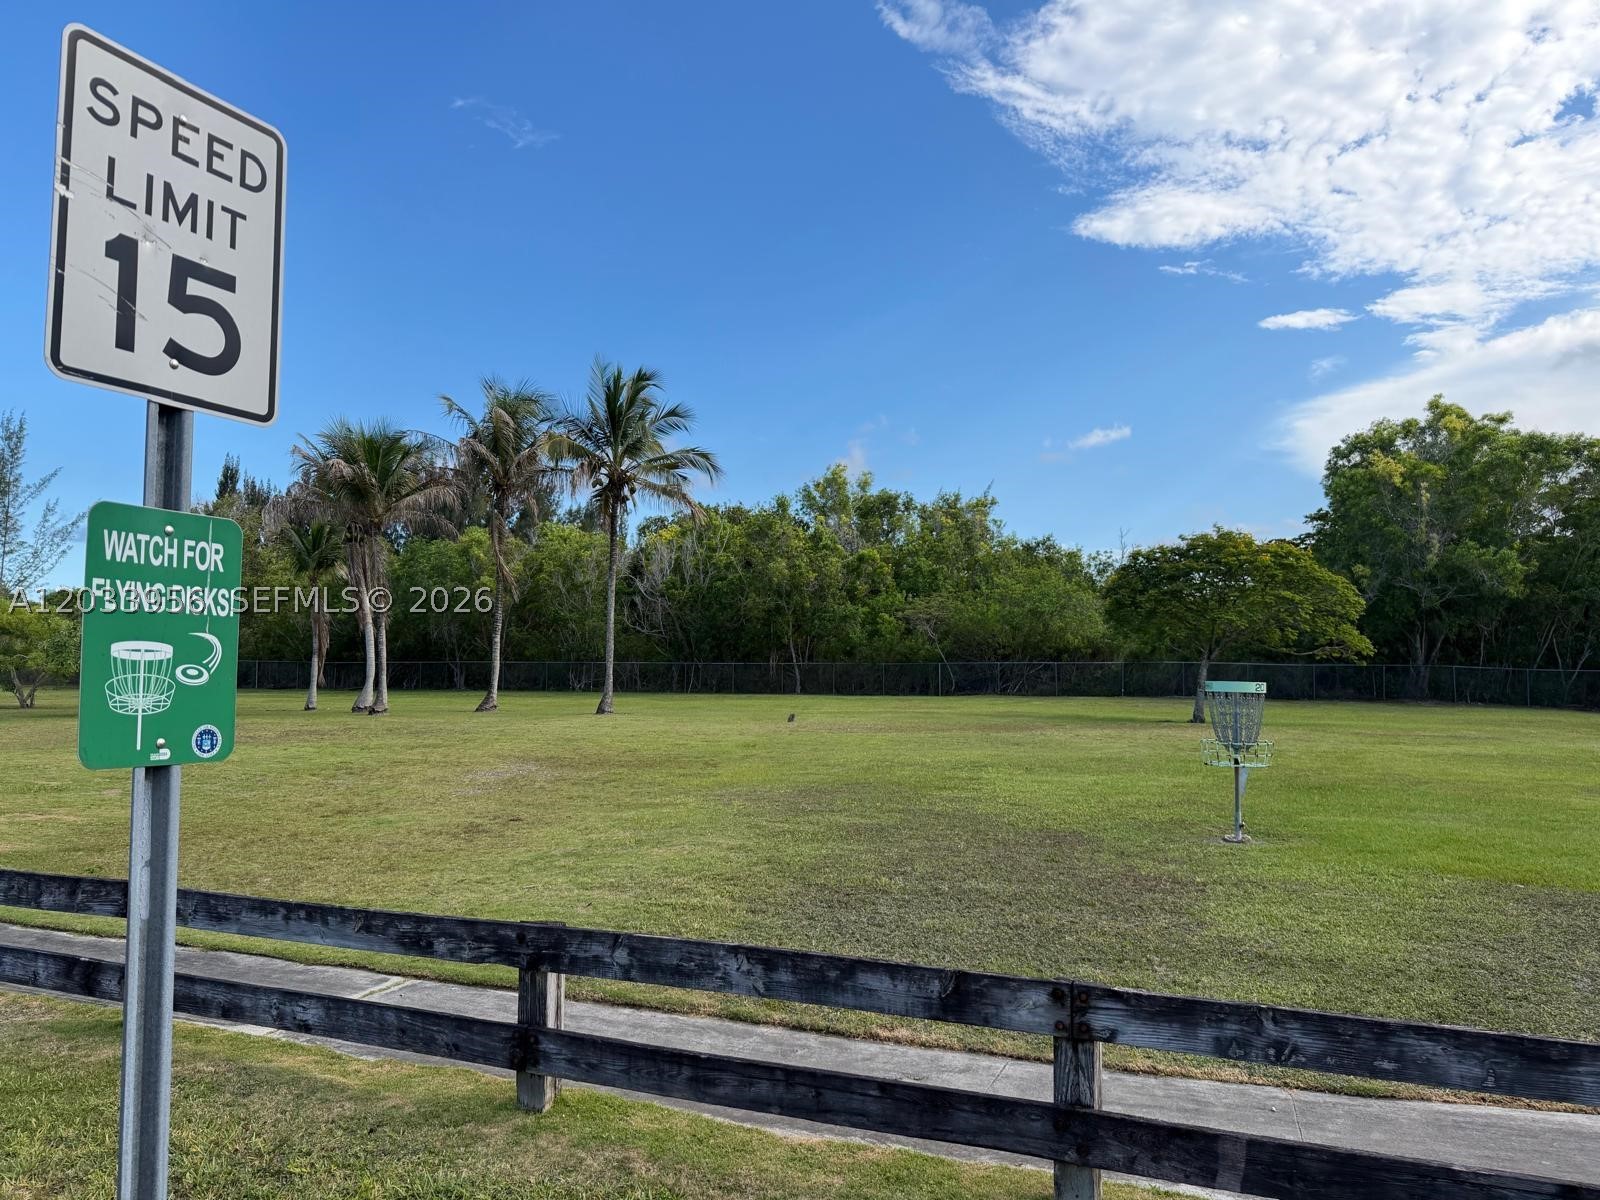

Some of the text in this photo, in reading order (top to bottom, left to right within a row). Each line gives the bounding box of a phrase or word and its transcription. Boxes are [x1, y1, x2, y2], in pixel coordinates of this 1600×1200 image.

[87, 76, 268, 194] SPEED
[106, 155, 247, 250] LIMIT
[104, 233, 241, 377] 15
[91, 577, 166, 613] FLYING
[103, 529, 224, 573] WATCH FOR
